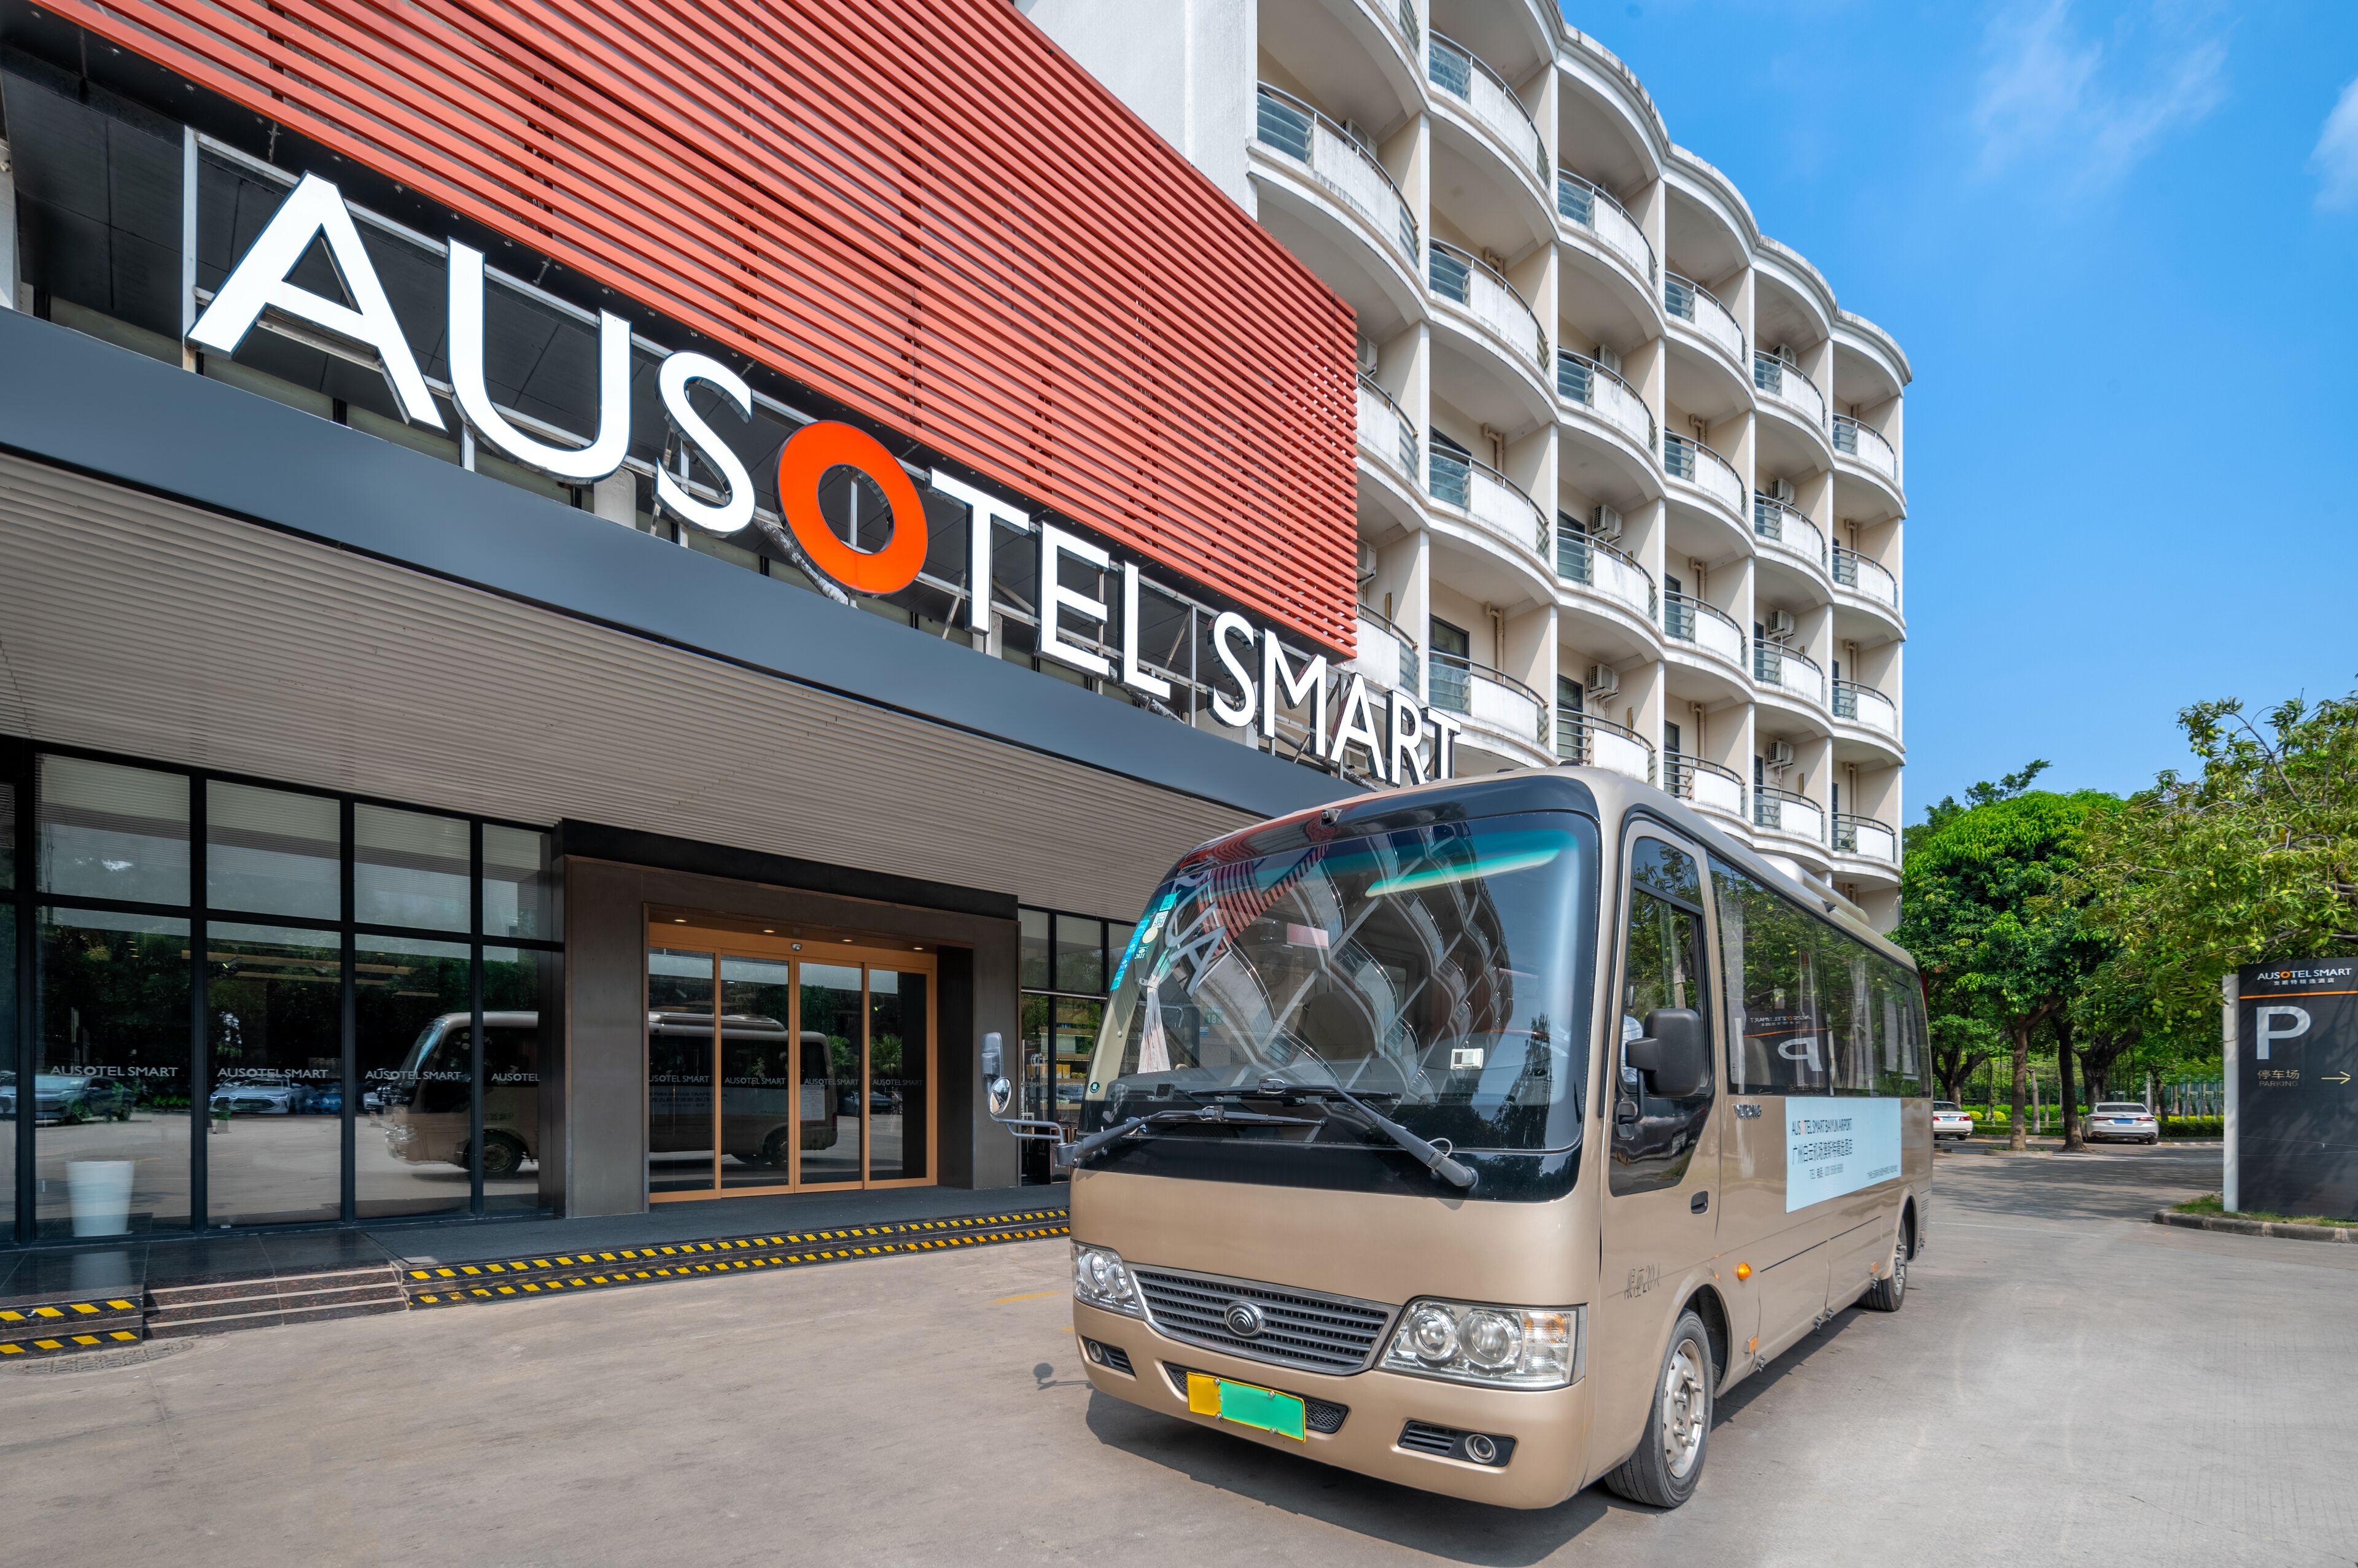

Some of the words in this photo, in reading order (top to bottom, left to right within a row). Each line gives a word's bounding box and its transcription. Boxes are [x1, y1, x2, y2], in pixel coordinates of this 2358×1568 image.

[185, 170, 1171, 700] AUSOTEL
[1208, 611, 1461, 788] SMART
[2257, 970, 2312, 980] AUSOTEL
[2313, 968, 2352, 977] SMART
[2255, 1006, 2311, 1060] P
[50, 1065, 125, 1077] AUSOTEL
[127, 1066, 178, 1077] SMART
[217, 1068, 284, 1078] AUSOTEL
[284, 1068, 329, 1079] SMART
[365, 1070, 421, 1080] AUSOTEL
[422, 1071, 461, 1081] SMART
[2257, 1069, 2300, 1079] 停车场
[491, 1073, 540, 1082] AUSOTEL
